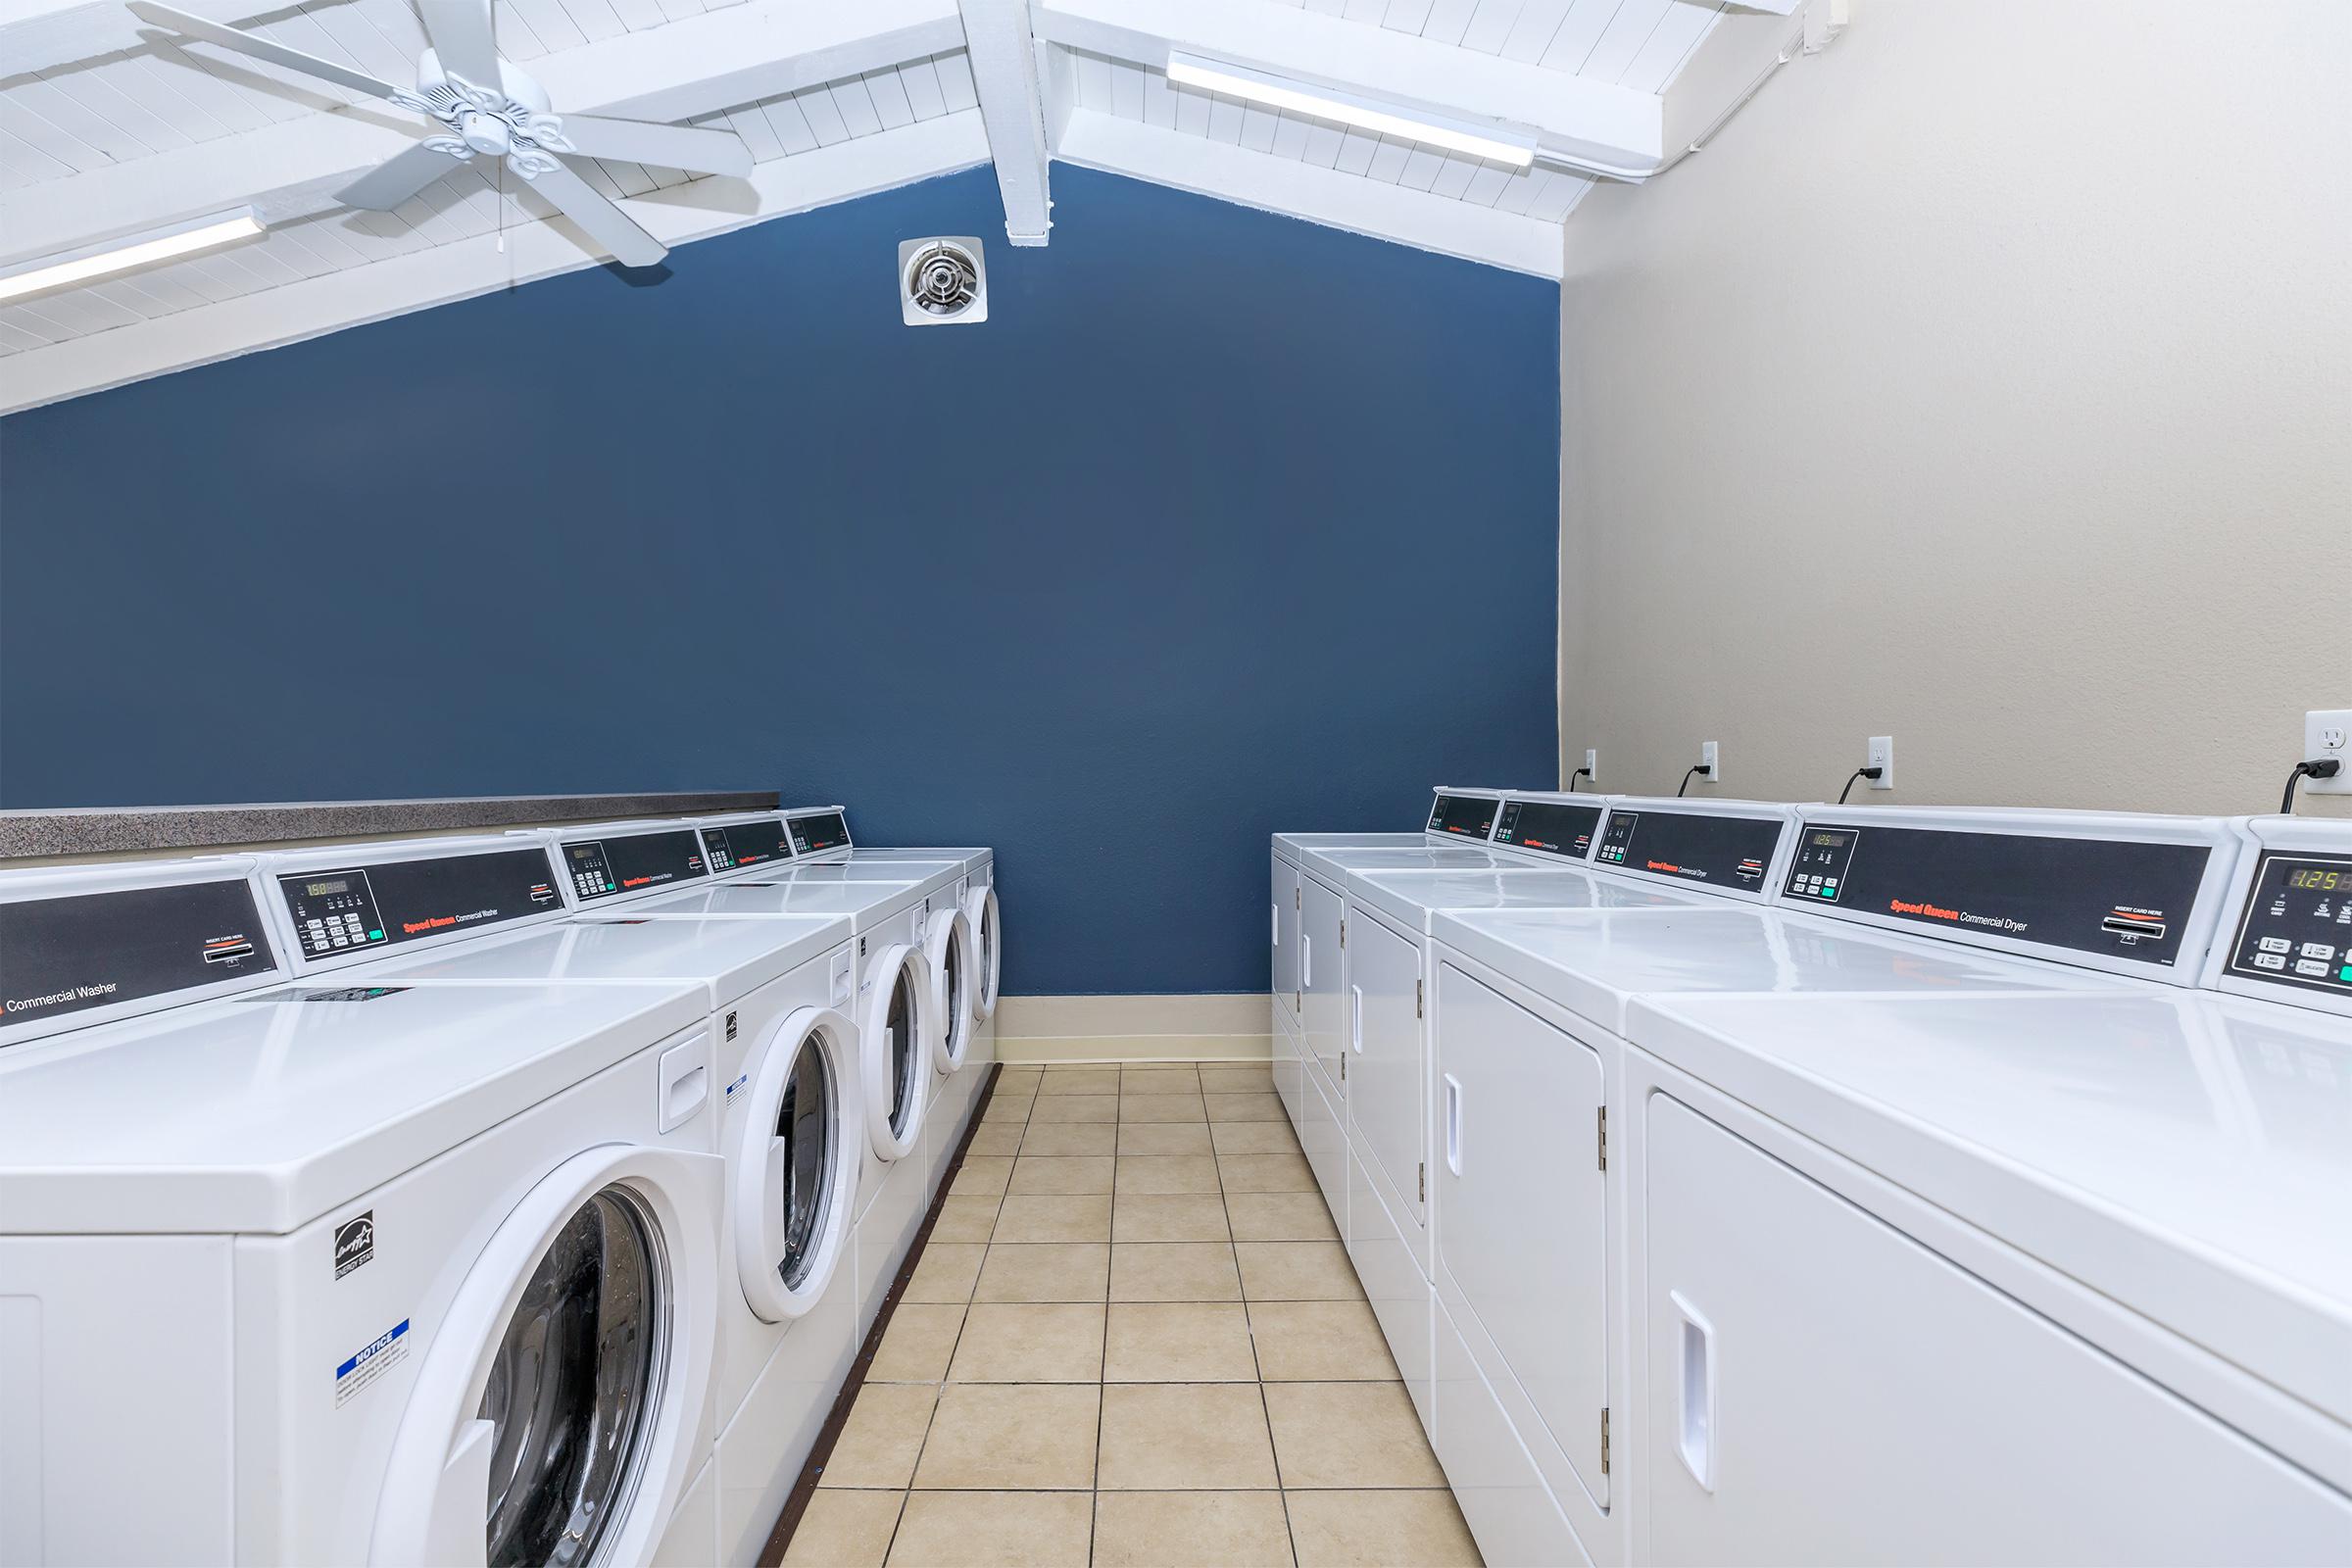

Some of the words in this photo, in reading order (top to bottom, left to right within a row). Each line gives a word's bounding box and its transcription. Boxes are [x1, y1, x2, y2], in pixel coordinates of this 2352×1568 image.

[2297, 870, 2339, 890] 1.25
[403, 919, 431, 933] Speed
[429, 915, 456, 929] Queen
[455, 910, 482, 923] Commercial
[481, 908, 498, 917] Washer
[1890, 900, 1924, 913] Speed
[1924, 904, 1960, 921] Queen
[1960, 911, 2004, 928] Commercial
[2004, 918, 2028, 933] Dryer
[6, 988, 76, 1011] Commercial
[76, 982, 118, 998] Washer
[356, 1331, 393, 1366] NOTICE
